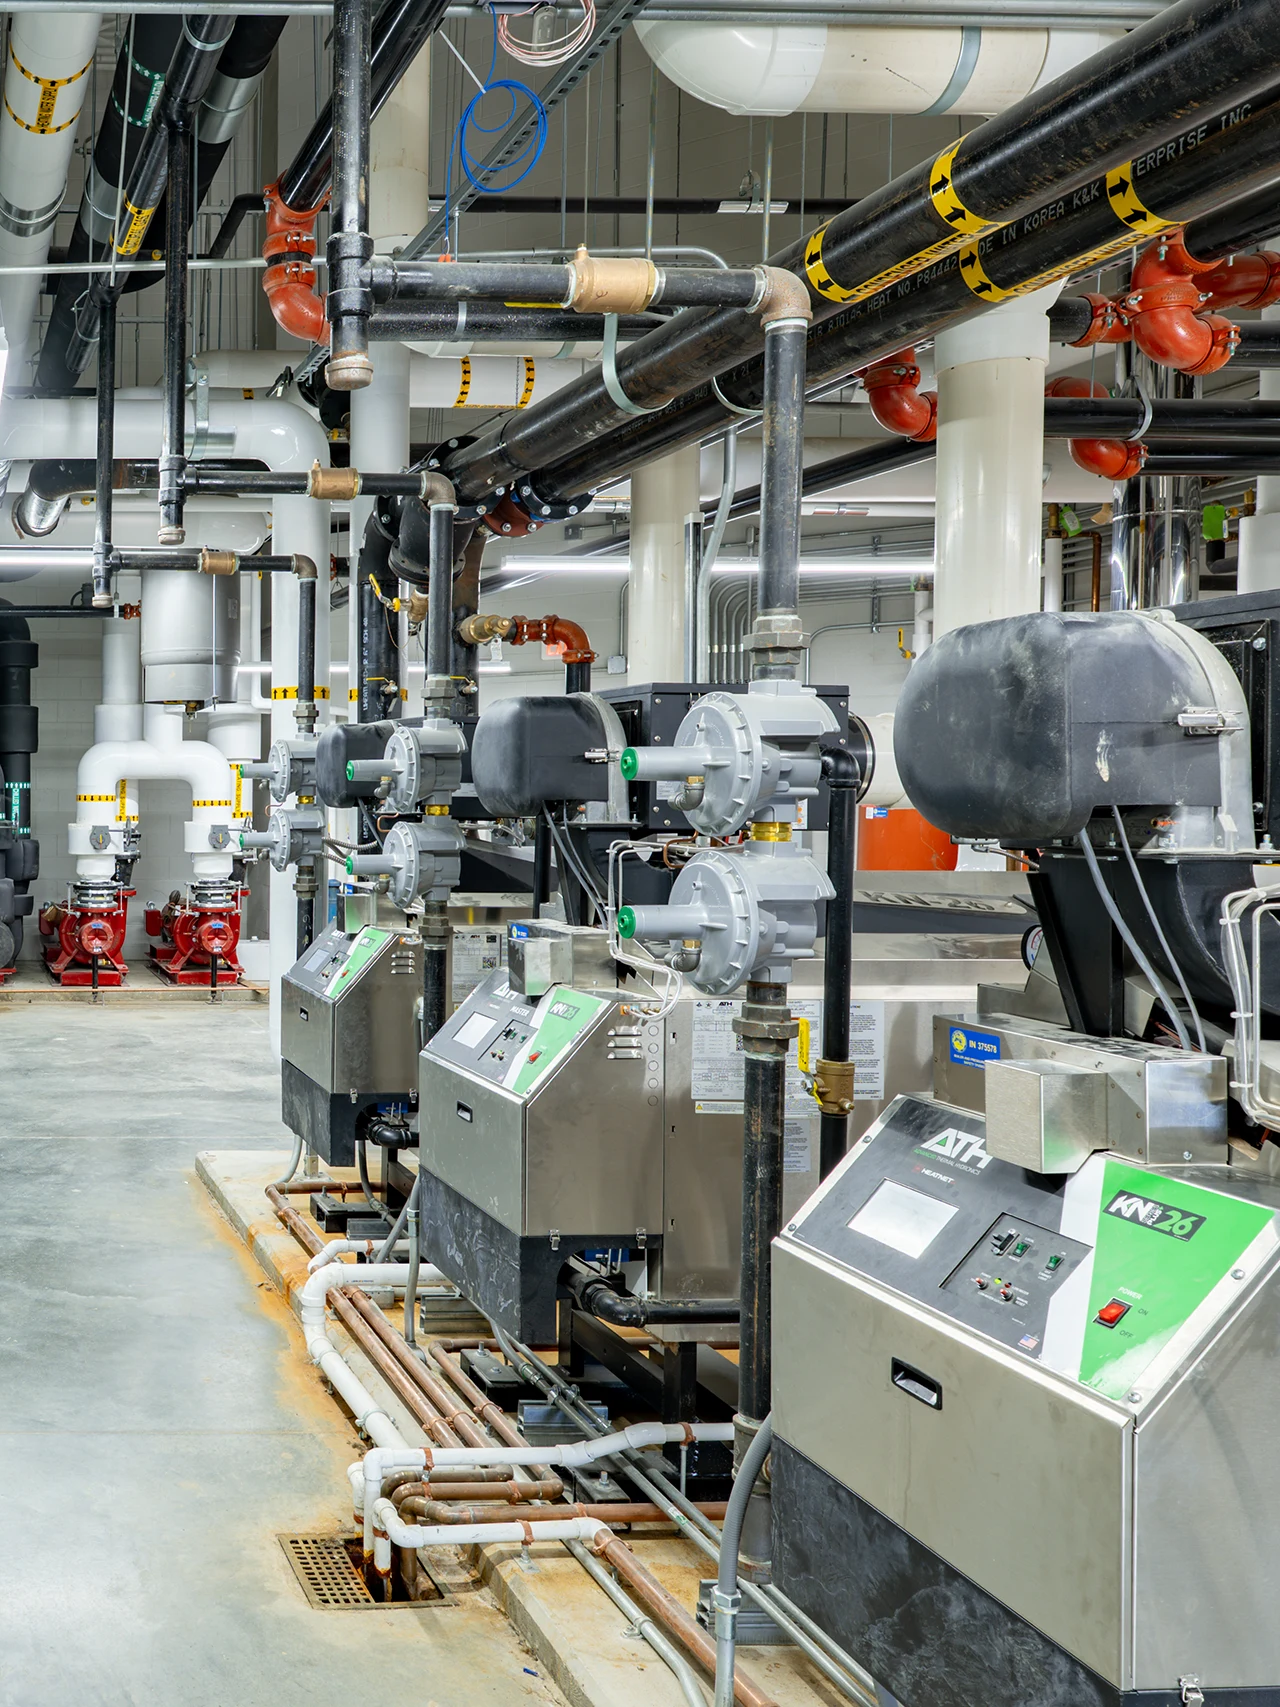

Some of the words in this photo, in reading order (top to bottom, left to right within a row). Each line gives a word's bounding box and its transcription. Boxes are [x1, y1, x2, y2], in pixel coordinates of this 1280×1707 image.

[1132, 125, 1207, 177] TERPRISE
[978, 236, 994, 255] DE
[1002, 226, 1017, 245] IN
[1024, 203, 1065, 235] KOREA
[1073, 182, 1100, 208] K&K
[867, 291, 891, 312] HEAT
[509, 1005, 530, 1017] MASTER
[969, 1040, 976, 1049] IN
[920, 1127, 993, 1169] ATH
[921, 1168, 954, 1184] HEATNET
[1108, 1195, 1155, 1222] KN
[1152, 1210, 1200, 1236] 26
[1146, 1209, 1163, 1226] PLUS
[1118, 1286, 1143, 1300] POWER
[1138, 1308, 1149, 1316] ON
[1119, 1330, 1134, 1339] OFF
